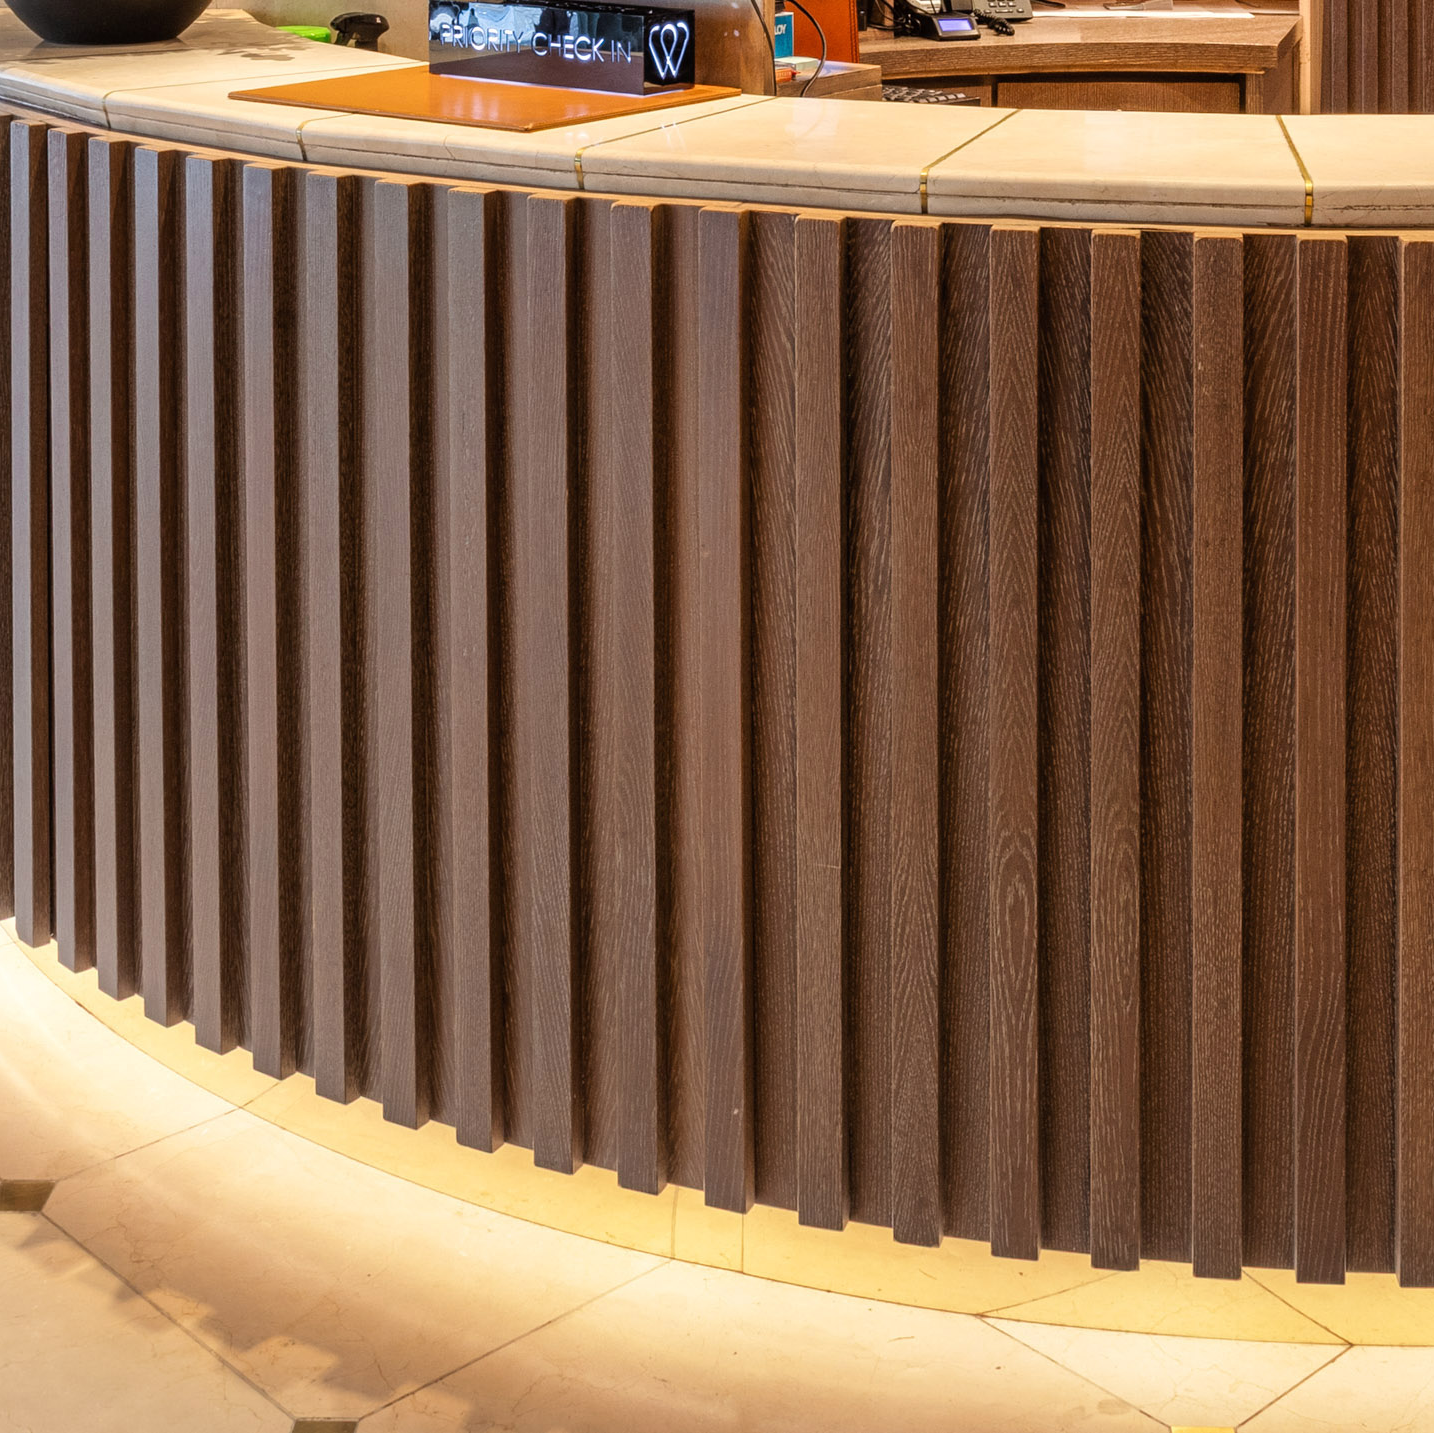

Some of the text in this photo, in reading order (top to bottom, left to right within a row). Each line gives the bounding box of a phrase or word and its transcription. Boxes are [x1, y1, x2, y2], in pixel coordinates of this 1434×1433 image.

[439, 24, 632, 64] PRIORITY CHECK IN
